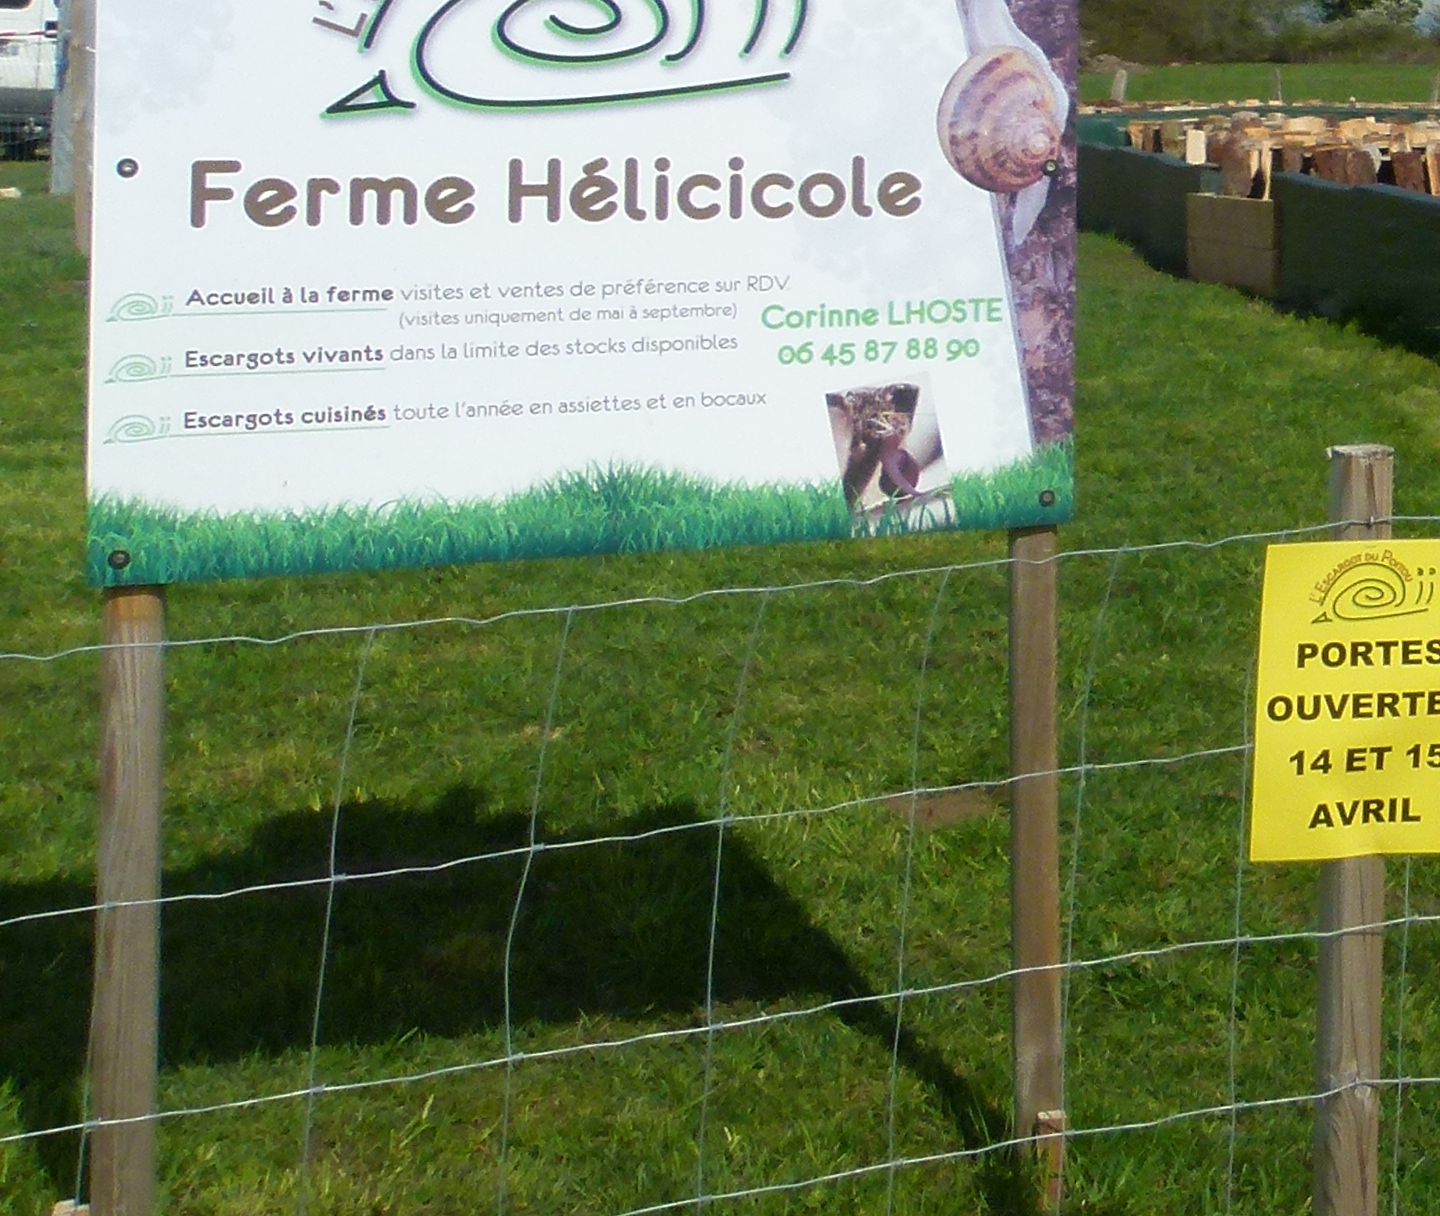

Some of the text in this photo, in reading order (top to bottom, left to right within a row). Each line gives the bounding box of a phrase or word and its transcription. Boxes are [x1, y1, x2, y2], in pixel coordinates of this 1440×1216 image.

[190, 155, 922, 229] Ferme Hélicicole
[185, 287, 275, 306] Accueil
[282, 286, 294, 304] à
[300, 286, 319, 303] la
[326, 286, 394, 302] ferme
[400, 283, 464, 301] visites
[470, 283, 491, 300] et
[499, 281, 564, 299] ventes
[570, 280, 596, 297] de
[602, 277, 710, 300] préférence
[715, 279, 741, 293] sur
[399, 303, 738, 329] (visites uniquement de mai à septembre)
[761, 297, 1003, 330] Corinne LHOSTE
[185, 334, 738, 370] Escargots vivants dans la limite des stocks disponibles
[777, 337, 980, 366] 06 45 87 88 90
[184, 390, 767, 432] Escargots cuisinés toute l'année en assiettes et en bocaux
[1364, 552, 1379, 561] DU
[1381, 549, 1414, 582] POITOU
[1288, 749, 1332, 776] 14
[1346, 746, 1393, 772] ET
[1308, 798, 1422, 829] AVRIL
